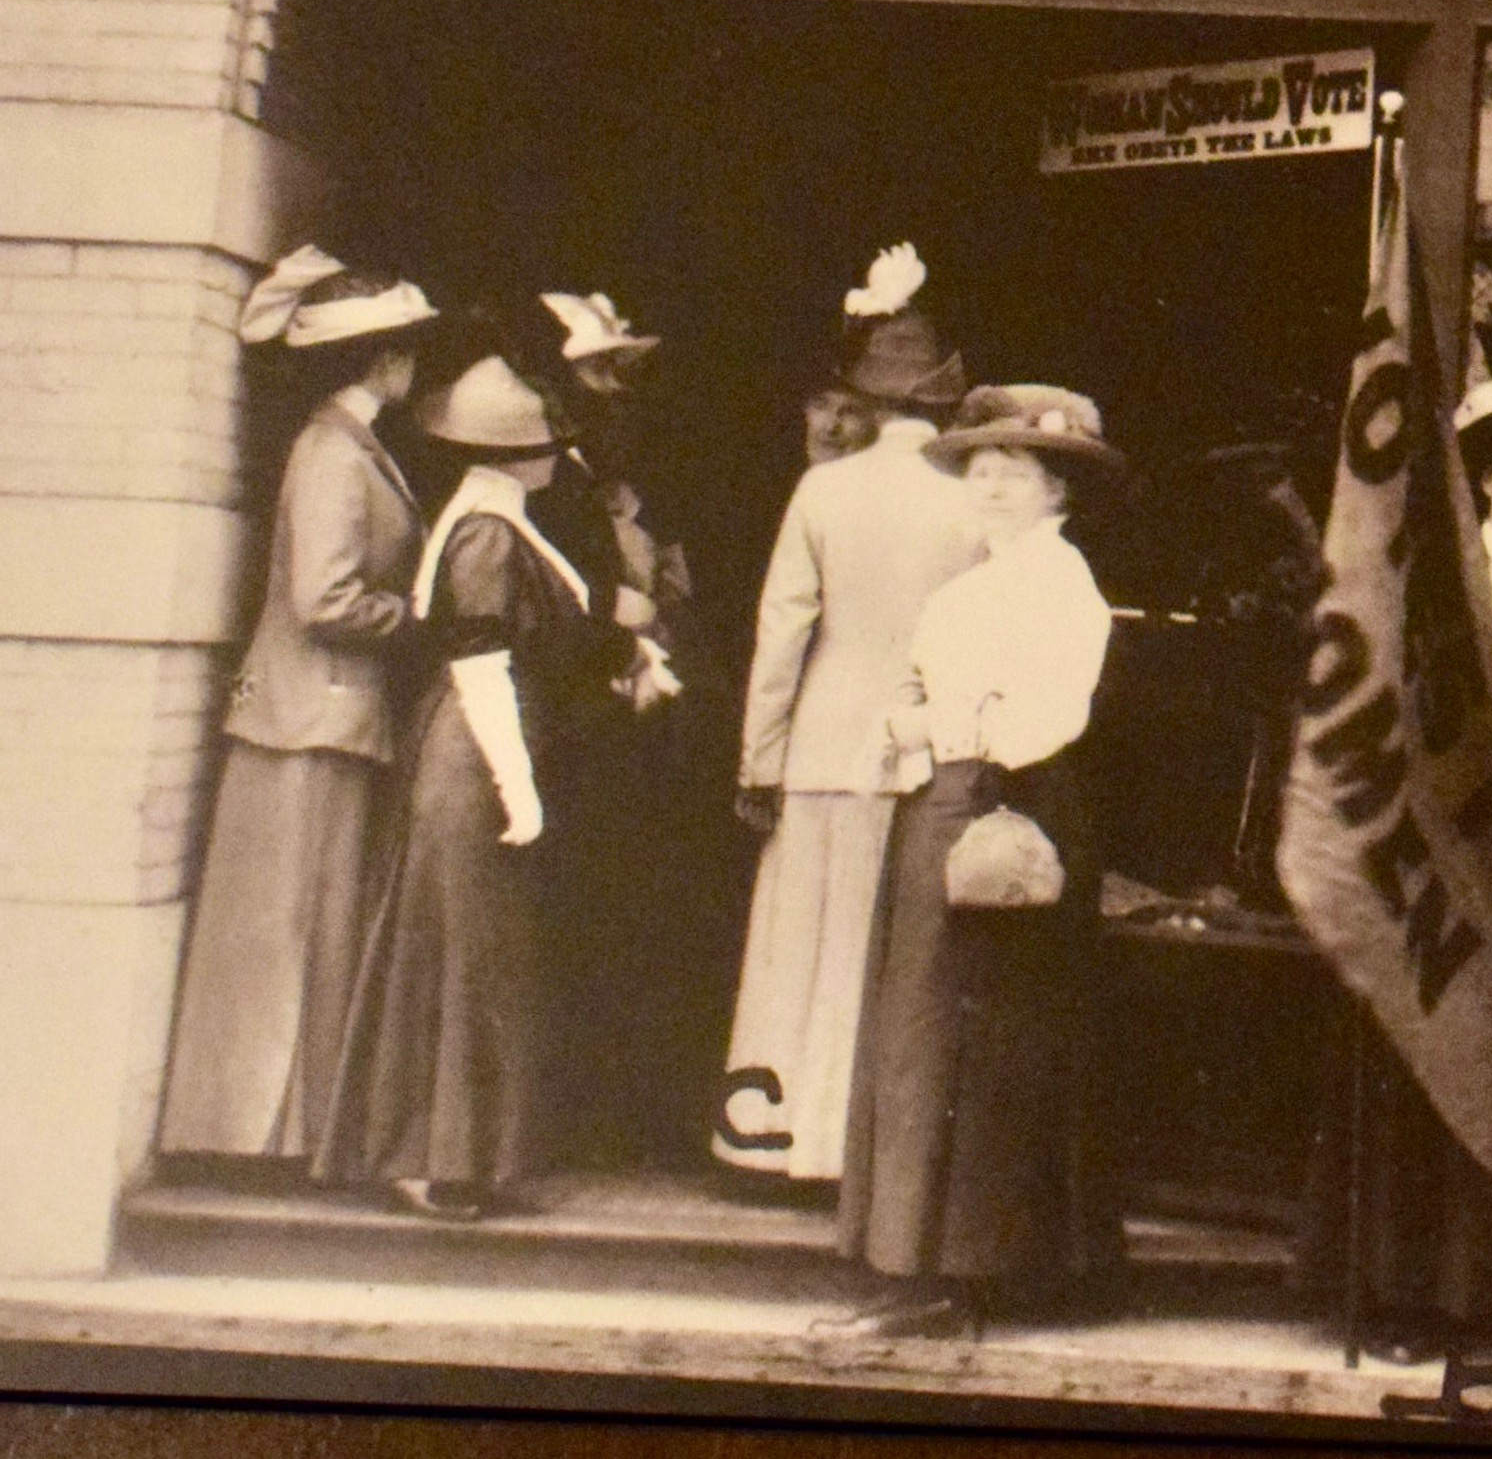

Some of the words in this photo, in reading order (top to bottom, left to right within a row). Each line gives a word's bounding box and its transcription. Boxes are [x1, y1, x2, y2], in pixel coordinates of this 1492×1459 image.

[1282, 58, 1369, 126] VOTE
[1263, 126, 1331, 150] LAWS
[711, 1066, 792, 1151] C
